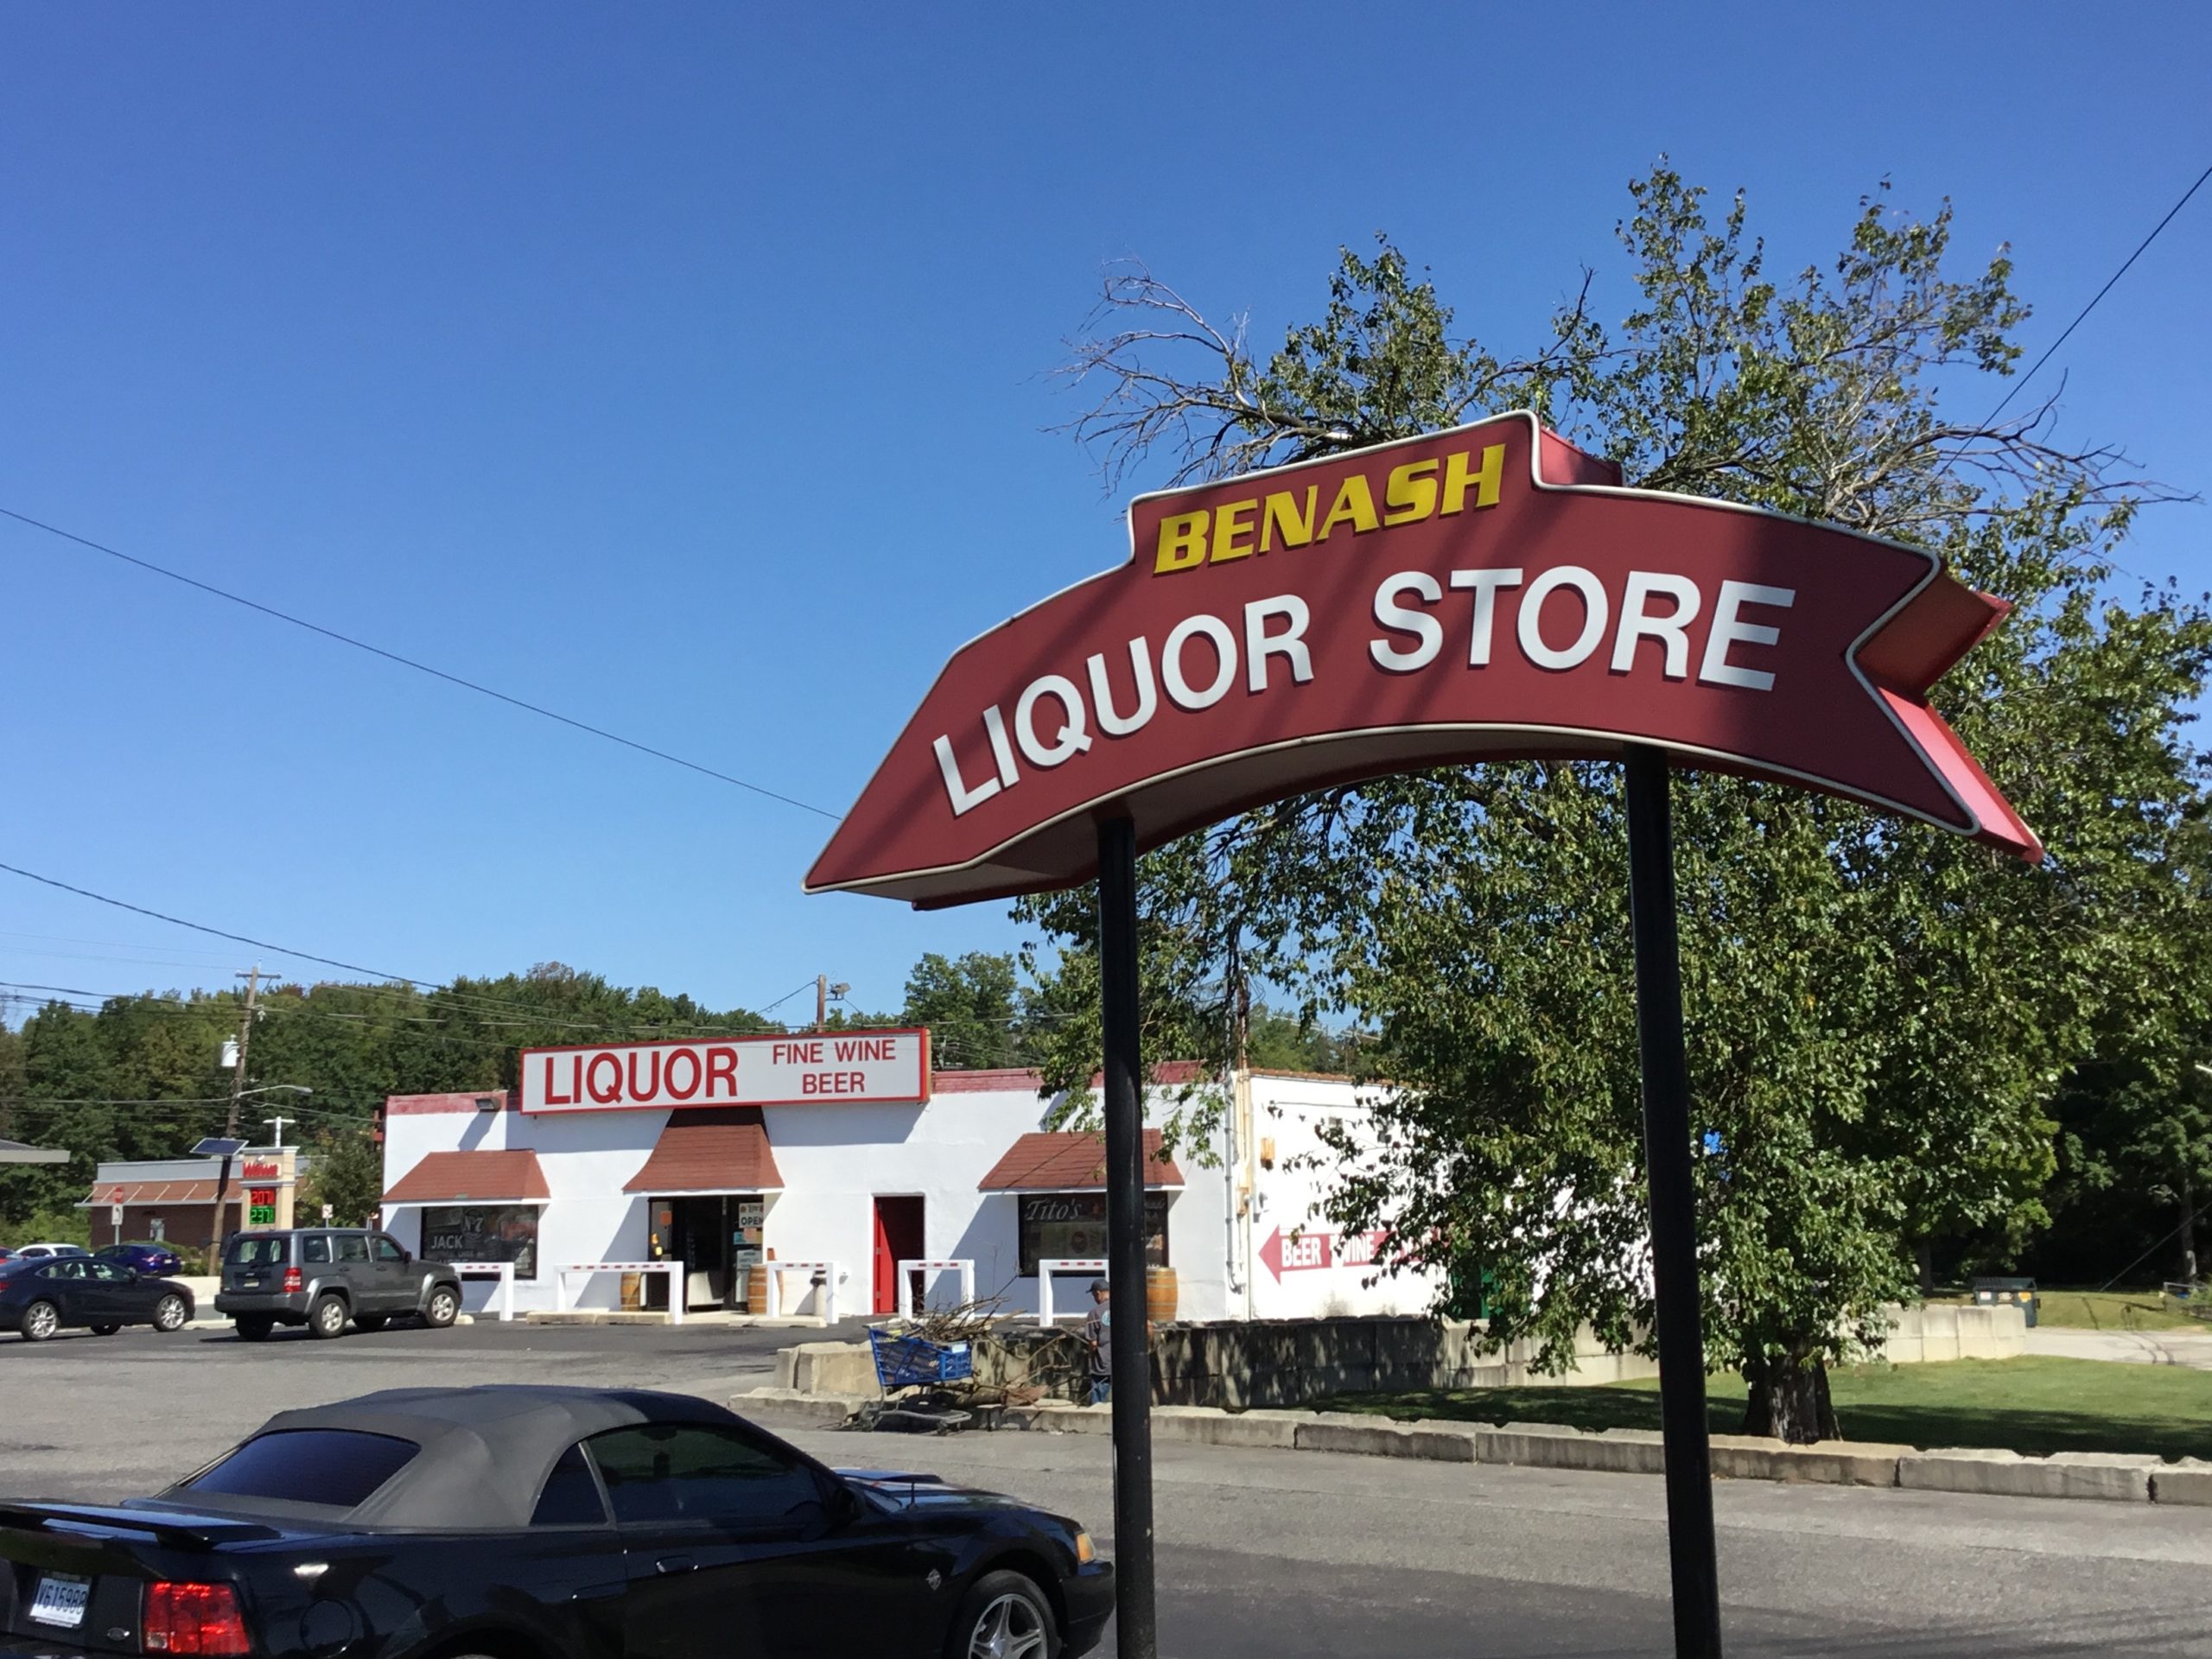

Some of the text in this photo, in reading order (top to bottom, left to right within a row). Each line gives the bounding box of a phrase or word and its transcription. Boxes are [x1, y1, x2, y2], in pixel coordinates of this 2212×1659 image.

[1154, 443, 1506, 575] BENASH
[933, 564, 1796, 817] LIQUOR STORE
[545, 1039, 896, 1105] LIQUOR FINE WINE
[802, 1071, 865, 1095] BEER
[1023, 1198, 1083, 1221] Tito's
[431, 1234, 463, 1249] JACK
[1281, 1236, 1323, 1268] BEER
